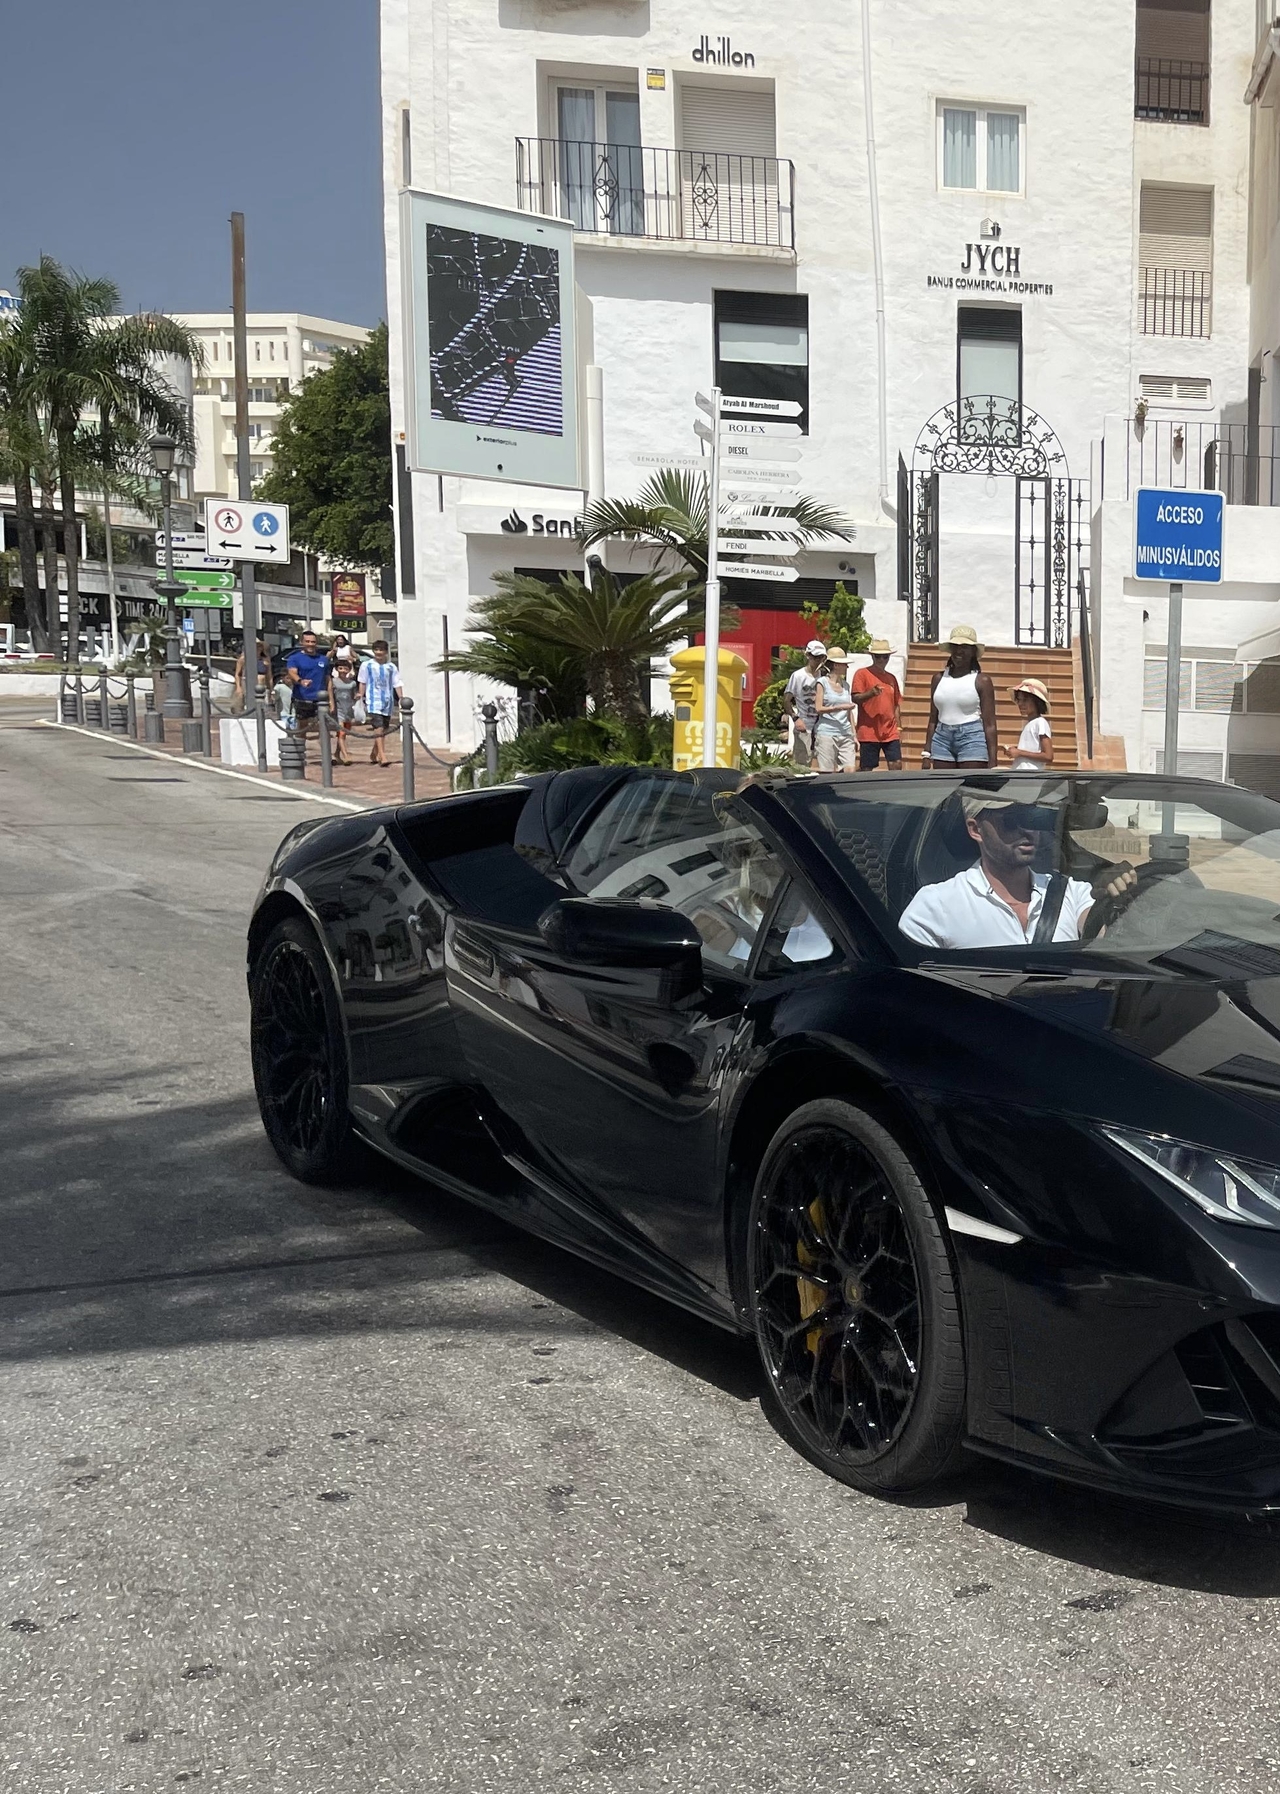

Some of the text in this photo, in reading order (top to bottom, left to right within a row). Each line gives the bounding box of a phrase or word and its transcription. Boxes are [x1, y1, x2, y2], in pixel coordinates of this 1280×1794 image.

[692, 35, 755, 68] dhillon
[961, 244, 1021, 276] JYCH
[927, 276, 1053, 295] BANUS COMMERCIAL PROPERTIES
[728, 424, 766, 434] ROLEX
[728, 446, 749, 455] DIESEL
[728, 468, 790, 478] CAROLINA HERRERA
[1156, 505, 1204, 525] ACCESO
[726, 542, 747, 550] FENDI
[1137, 544, 1220, 568] MINUSVÁLIDOS
[751, 568, 785, 577] MARBELLA
[124, 600, 145, 617] TIME
